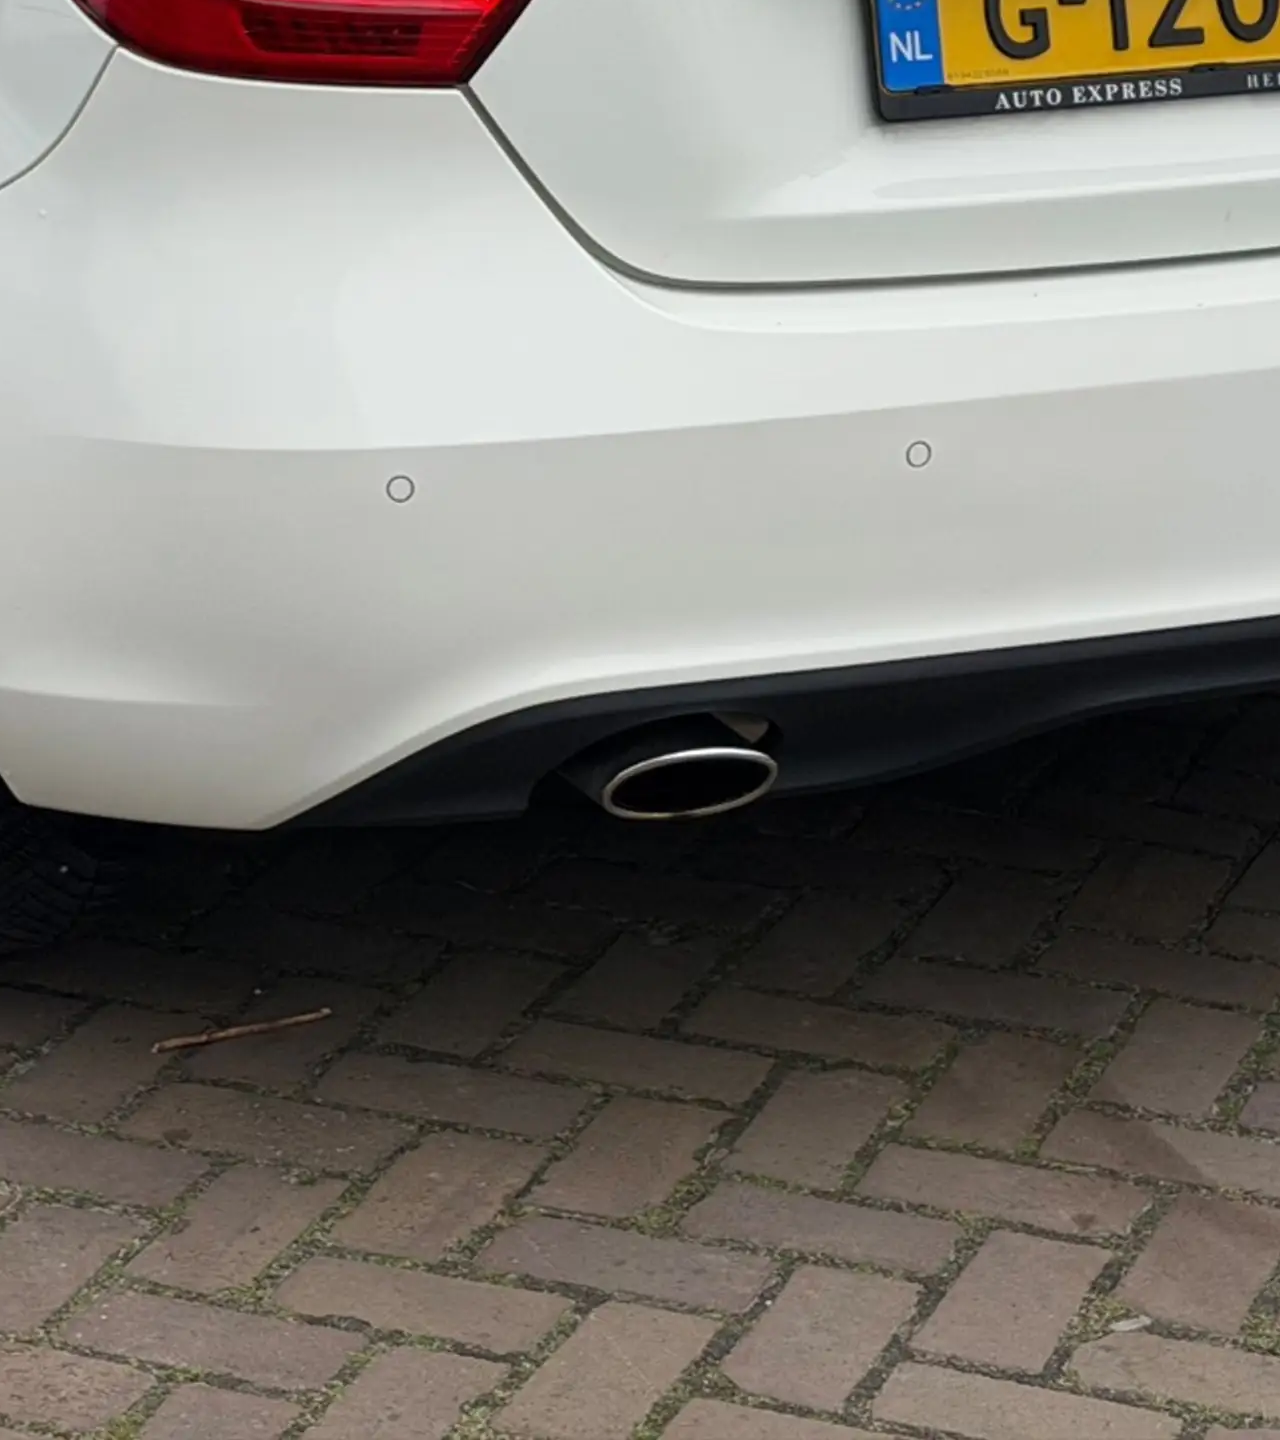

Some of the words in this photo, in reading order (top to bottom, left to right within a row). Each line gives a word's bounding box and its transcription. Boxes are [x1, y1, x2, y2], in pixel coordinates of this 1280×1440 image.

[888, 30, 933, 63] NL
[995, 88, 1062, 110] AUTO
[1072, 77, 1184, 105] EXPRESS
